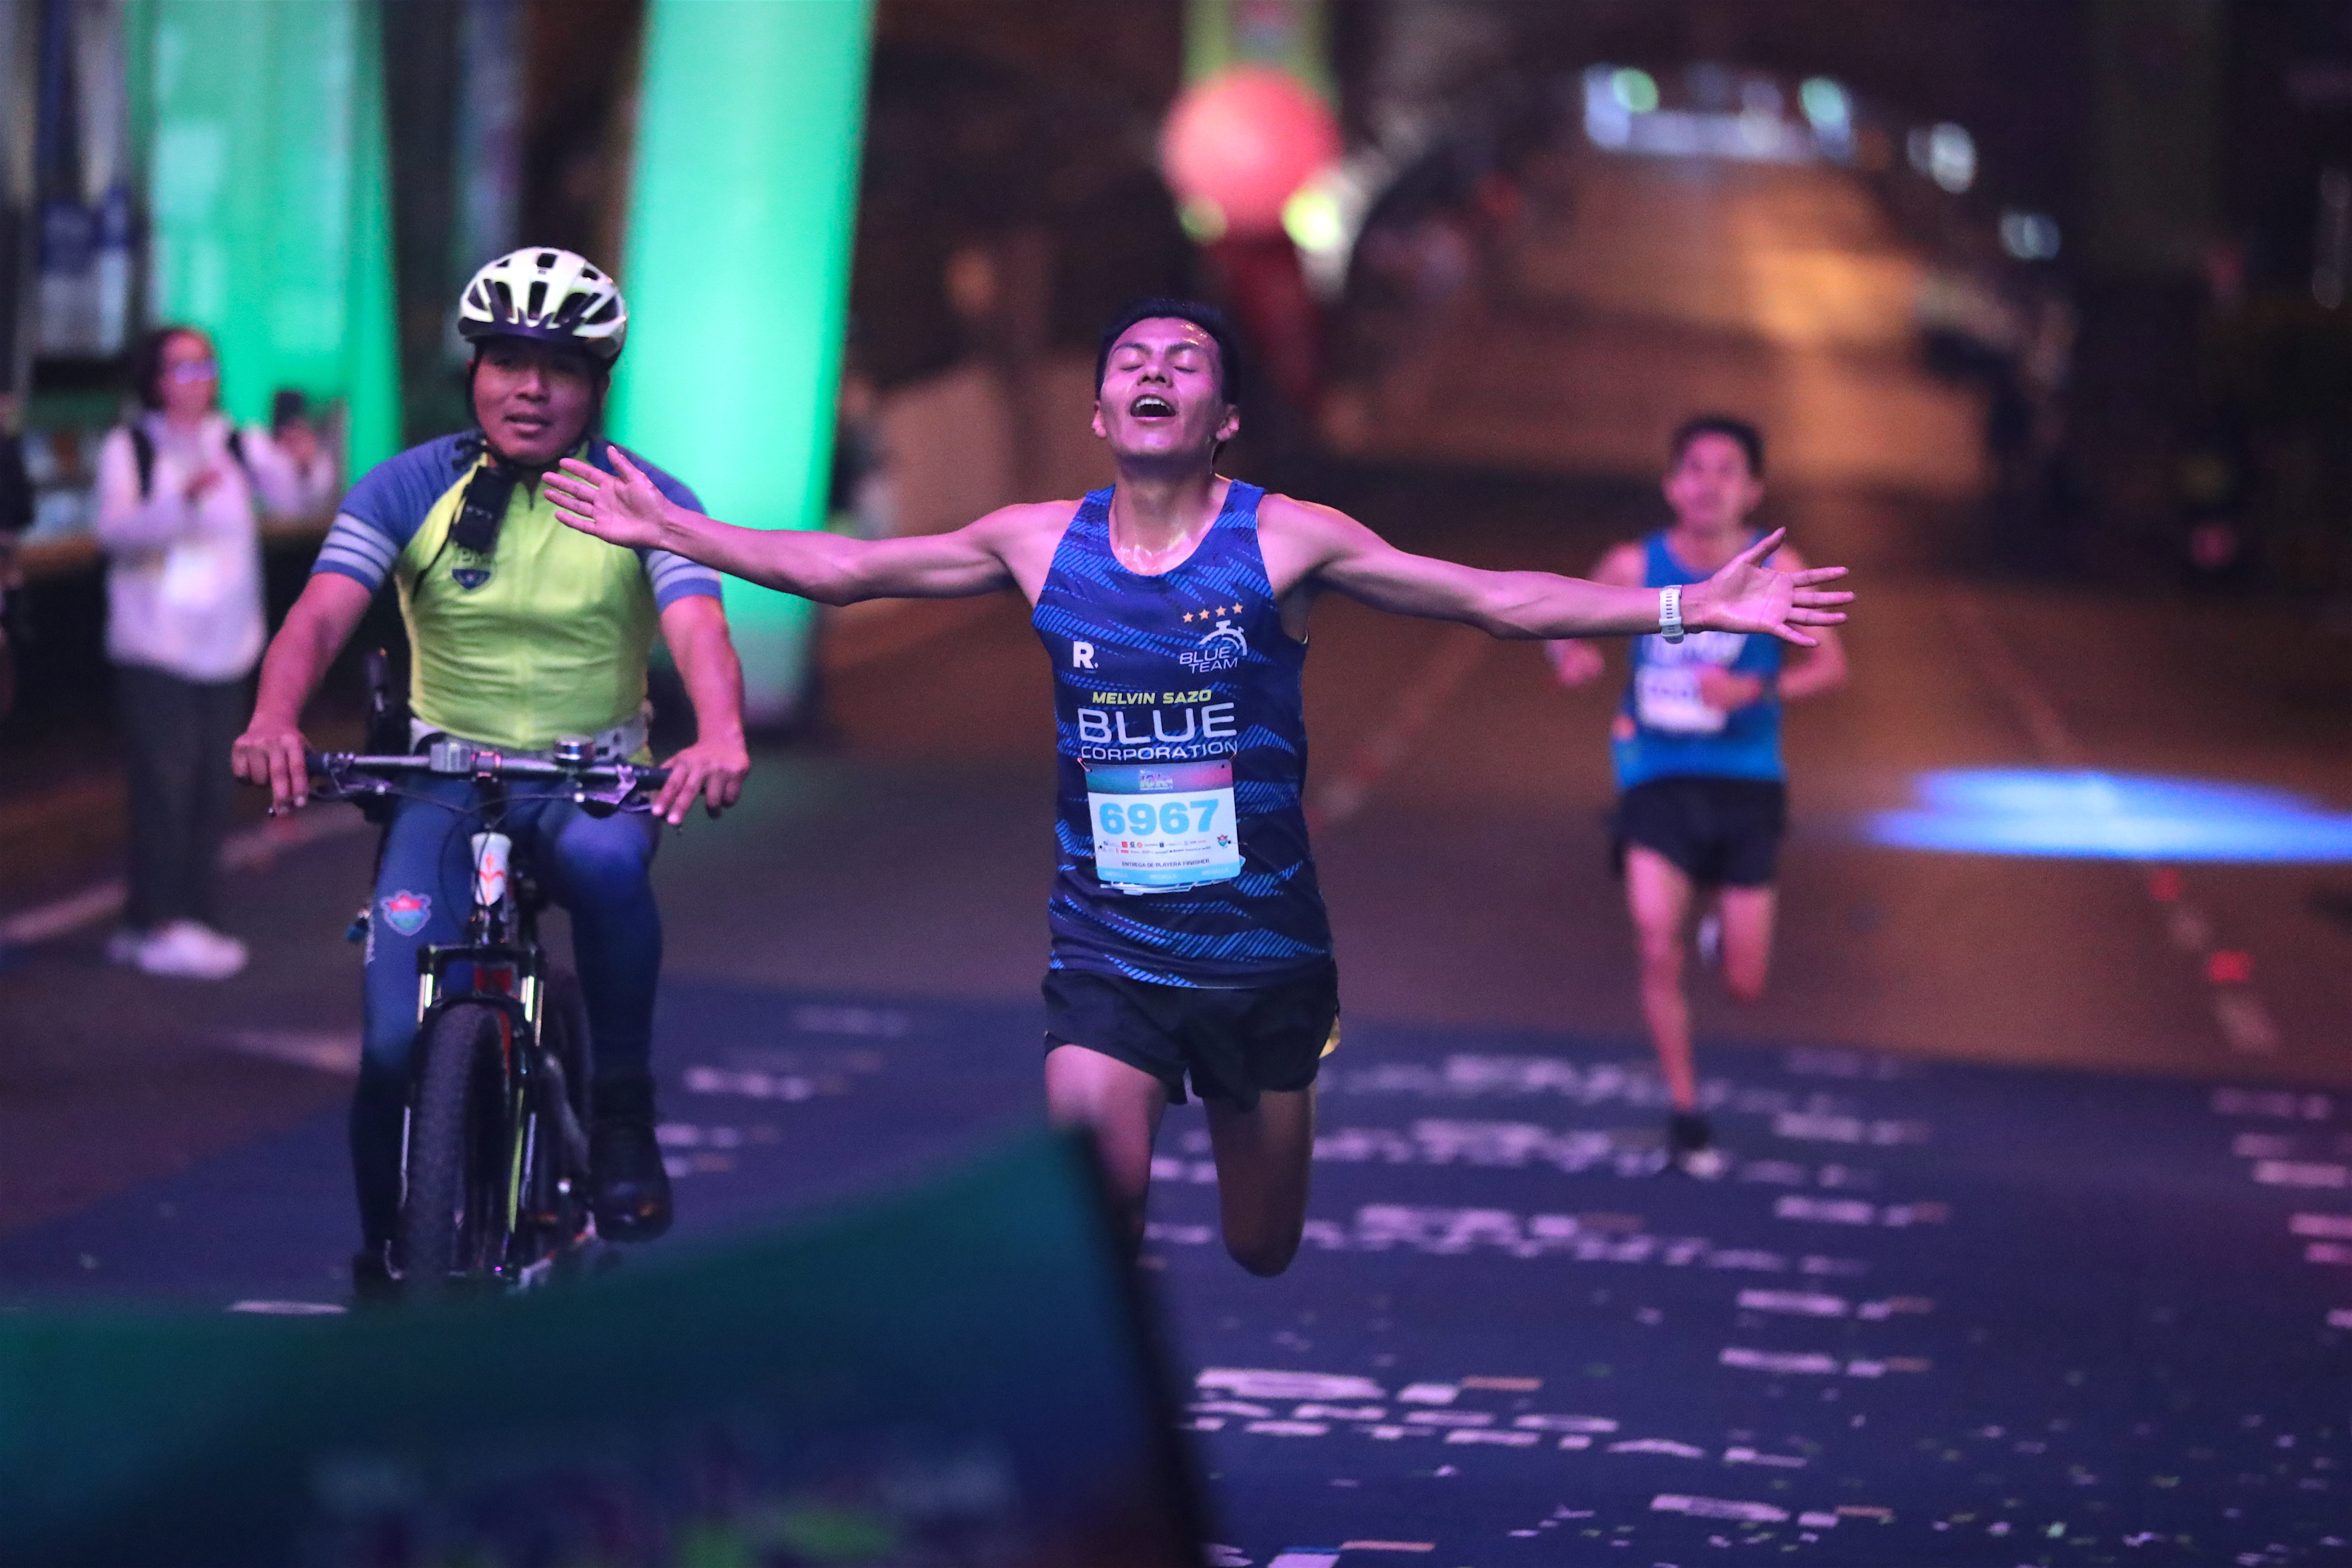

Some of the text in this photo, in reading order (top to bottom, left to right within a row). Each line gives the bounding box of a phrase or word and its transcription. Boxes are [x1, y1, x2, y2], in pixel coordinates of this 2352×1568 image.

[1179, 646, 1231, 665] BLUE
[1188, 658, 1239, 674] TEAM
[1092, 689, 1212, 704] MELVIN SAZO
[1078, 702, 1237, 744] BLUE
[1081, 741, 1238, 761] CORPORATION
[1099, 799, 1219, 836] 6967
[1182, 858, 1210, 867] FINISHER
